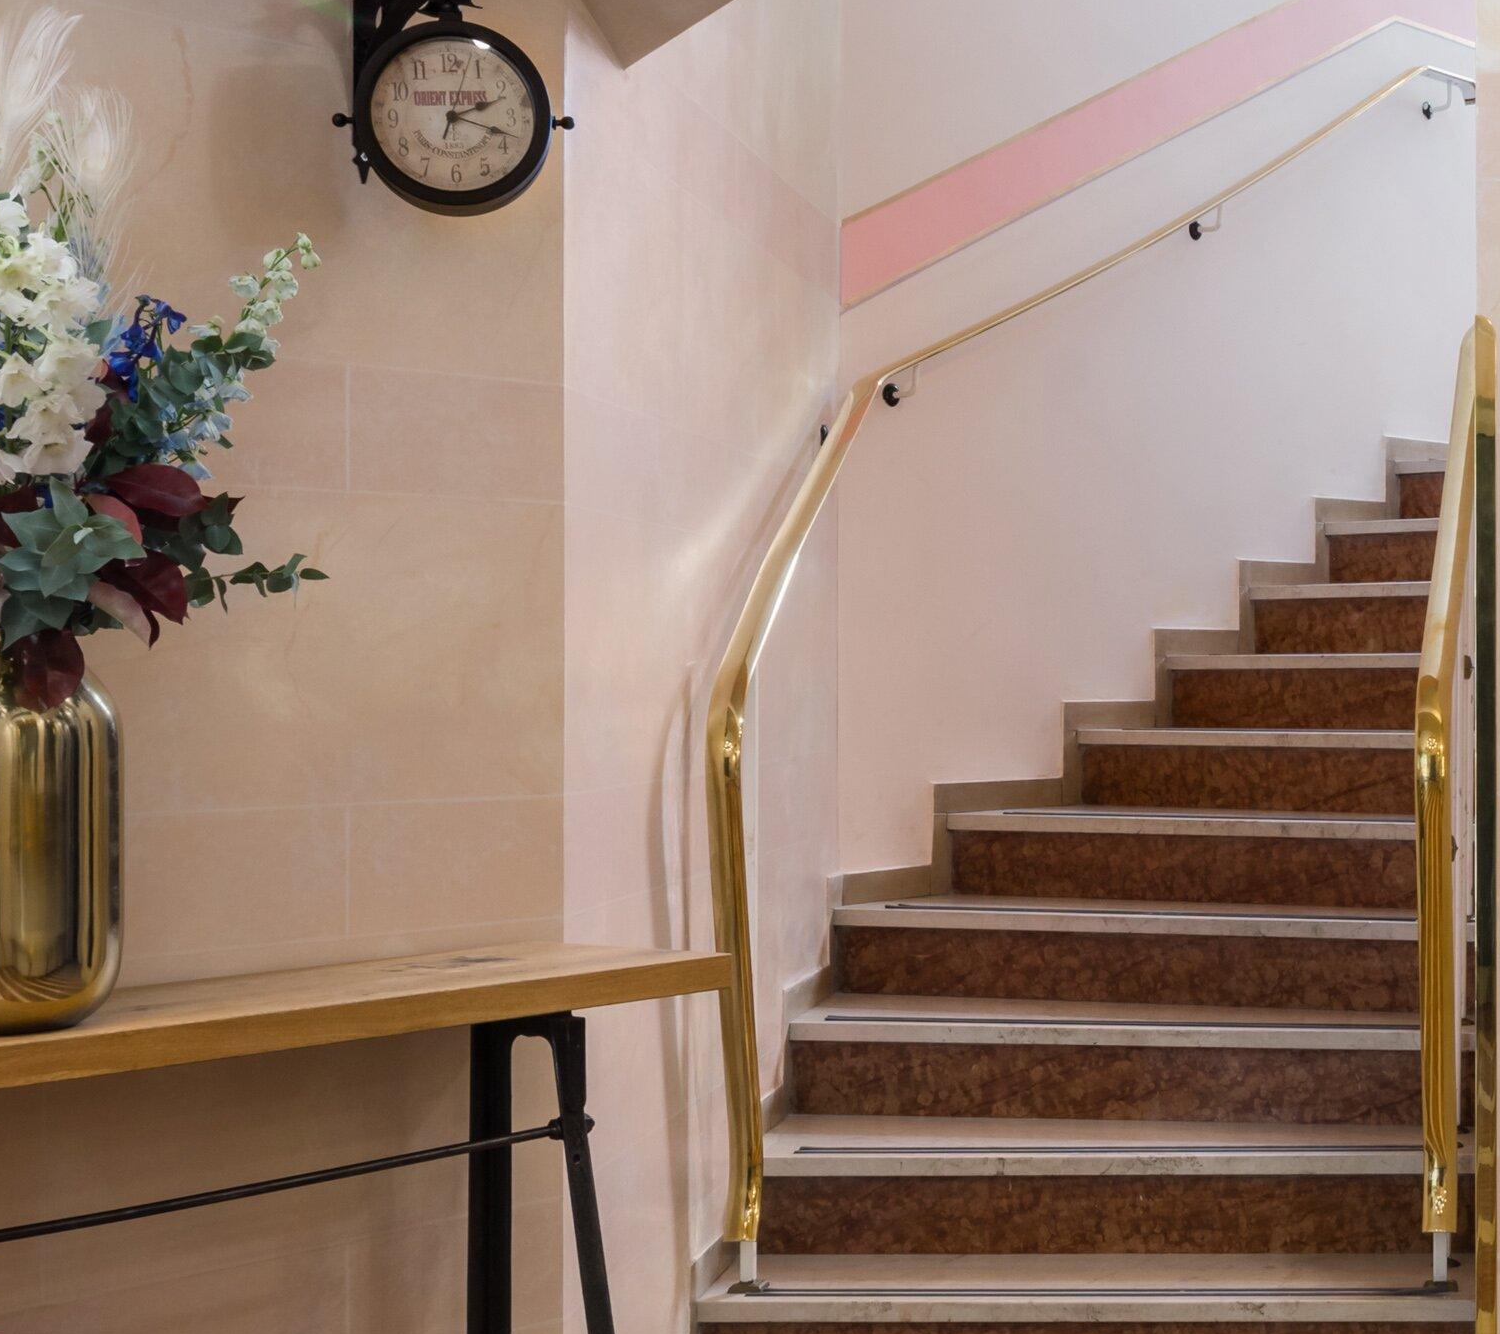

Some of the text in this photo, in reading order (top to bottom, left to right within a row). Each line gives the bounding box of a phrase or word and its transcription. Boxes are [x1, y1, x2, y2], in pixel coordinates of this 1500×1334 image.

[412, 59, 428, 81] 11
[441, 53, 458, 74] 12
[474, 59, 483, 80] 1
[391, 81, 409, 102] 10
[414, 90, 447, 107] ORIENT
[494, 80, 507, 100] 2
[387, 108, 399, 129] 9
[506, 107, 517, 127] 3
[398, 136, 410, 157] 8
[497, 135, 509, 155] 4
[420, 156, 431, 178] 7
[451, 164, 462, 184] 6
[479, 156, 491, 177] 5
